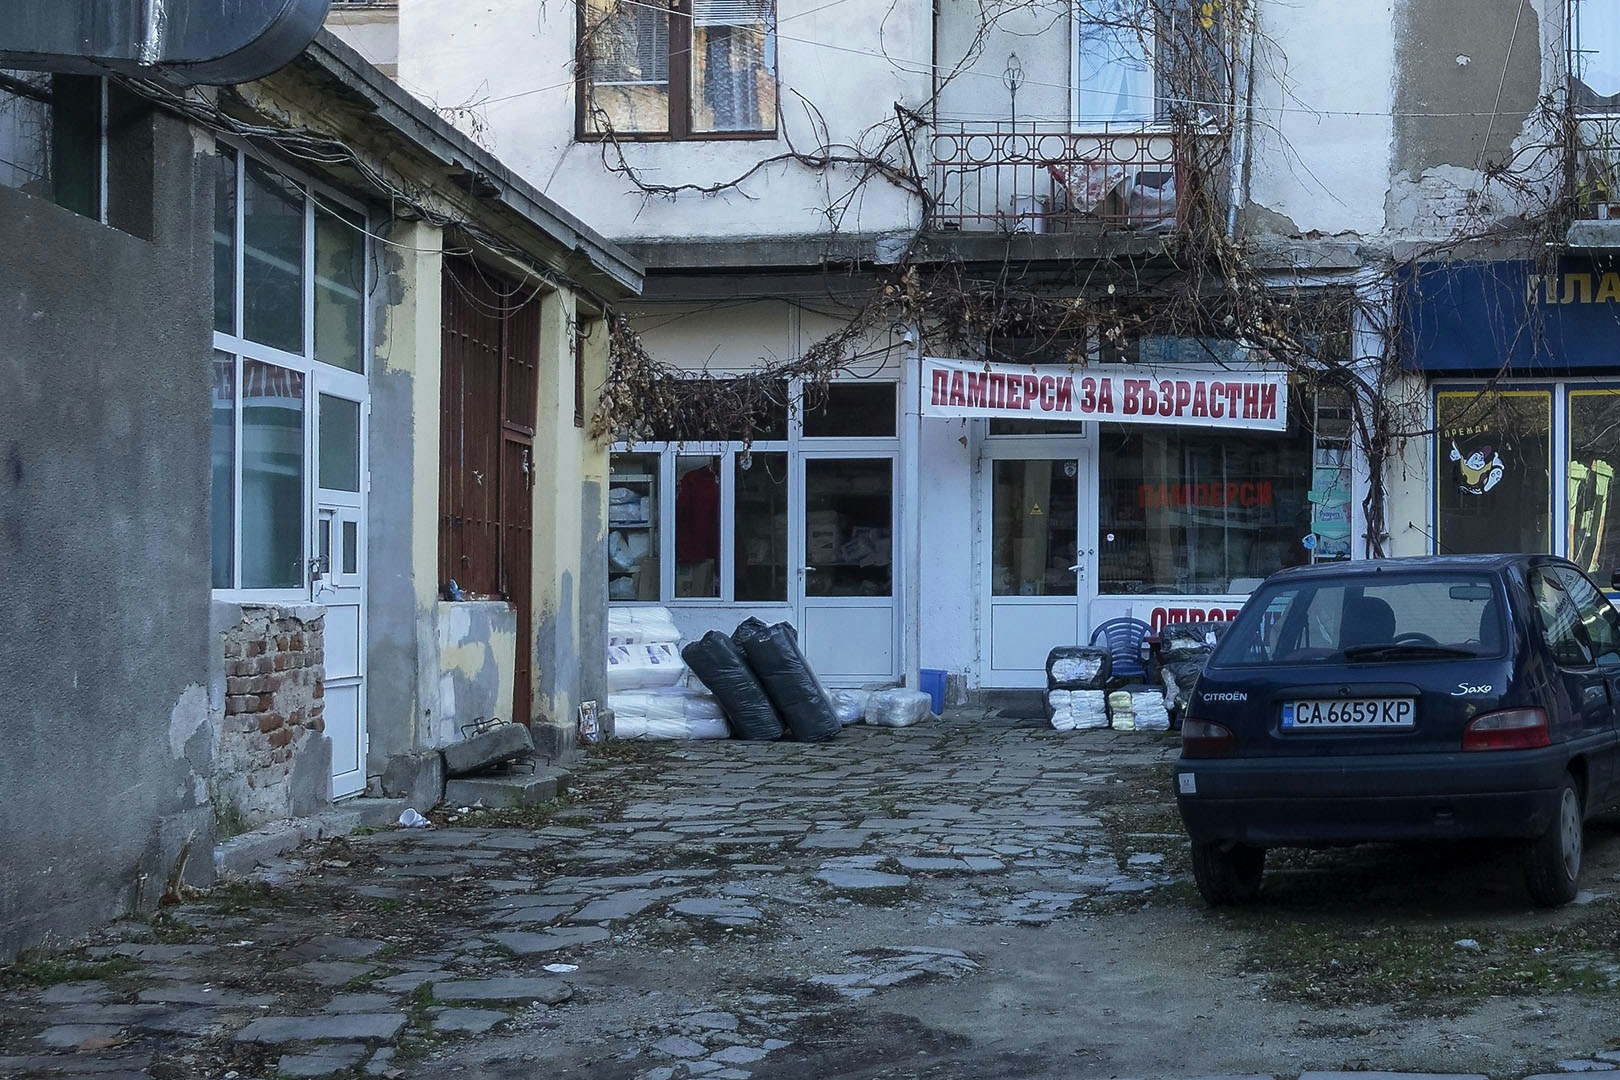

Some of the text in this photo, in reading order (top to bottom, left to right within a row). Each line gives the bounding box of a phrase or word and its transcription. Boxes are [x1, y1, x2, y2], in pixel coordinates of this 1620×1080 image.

[931, 369, 1278, 420] ПАМПЕРСИ ЗА ВЪЗРАСТНИ
[1138, 480, 1273, 509] ПАМПЕРСИ
[1203, 691, 1248, 701] CITROËN
[1450, 682, 1492, 696] Saxo
